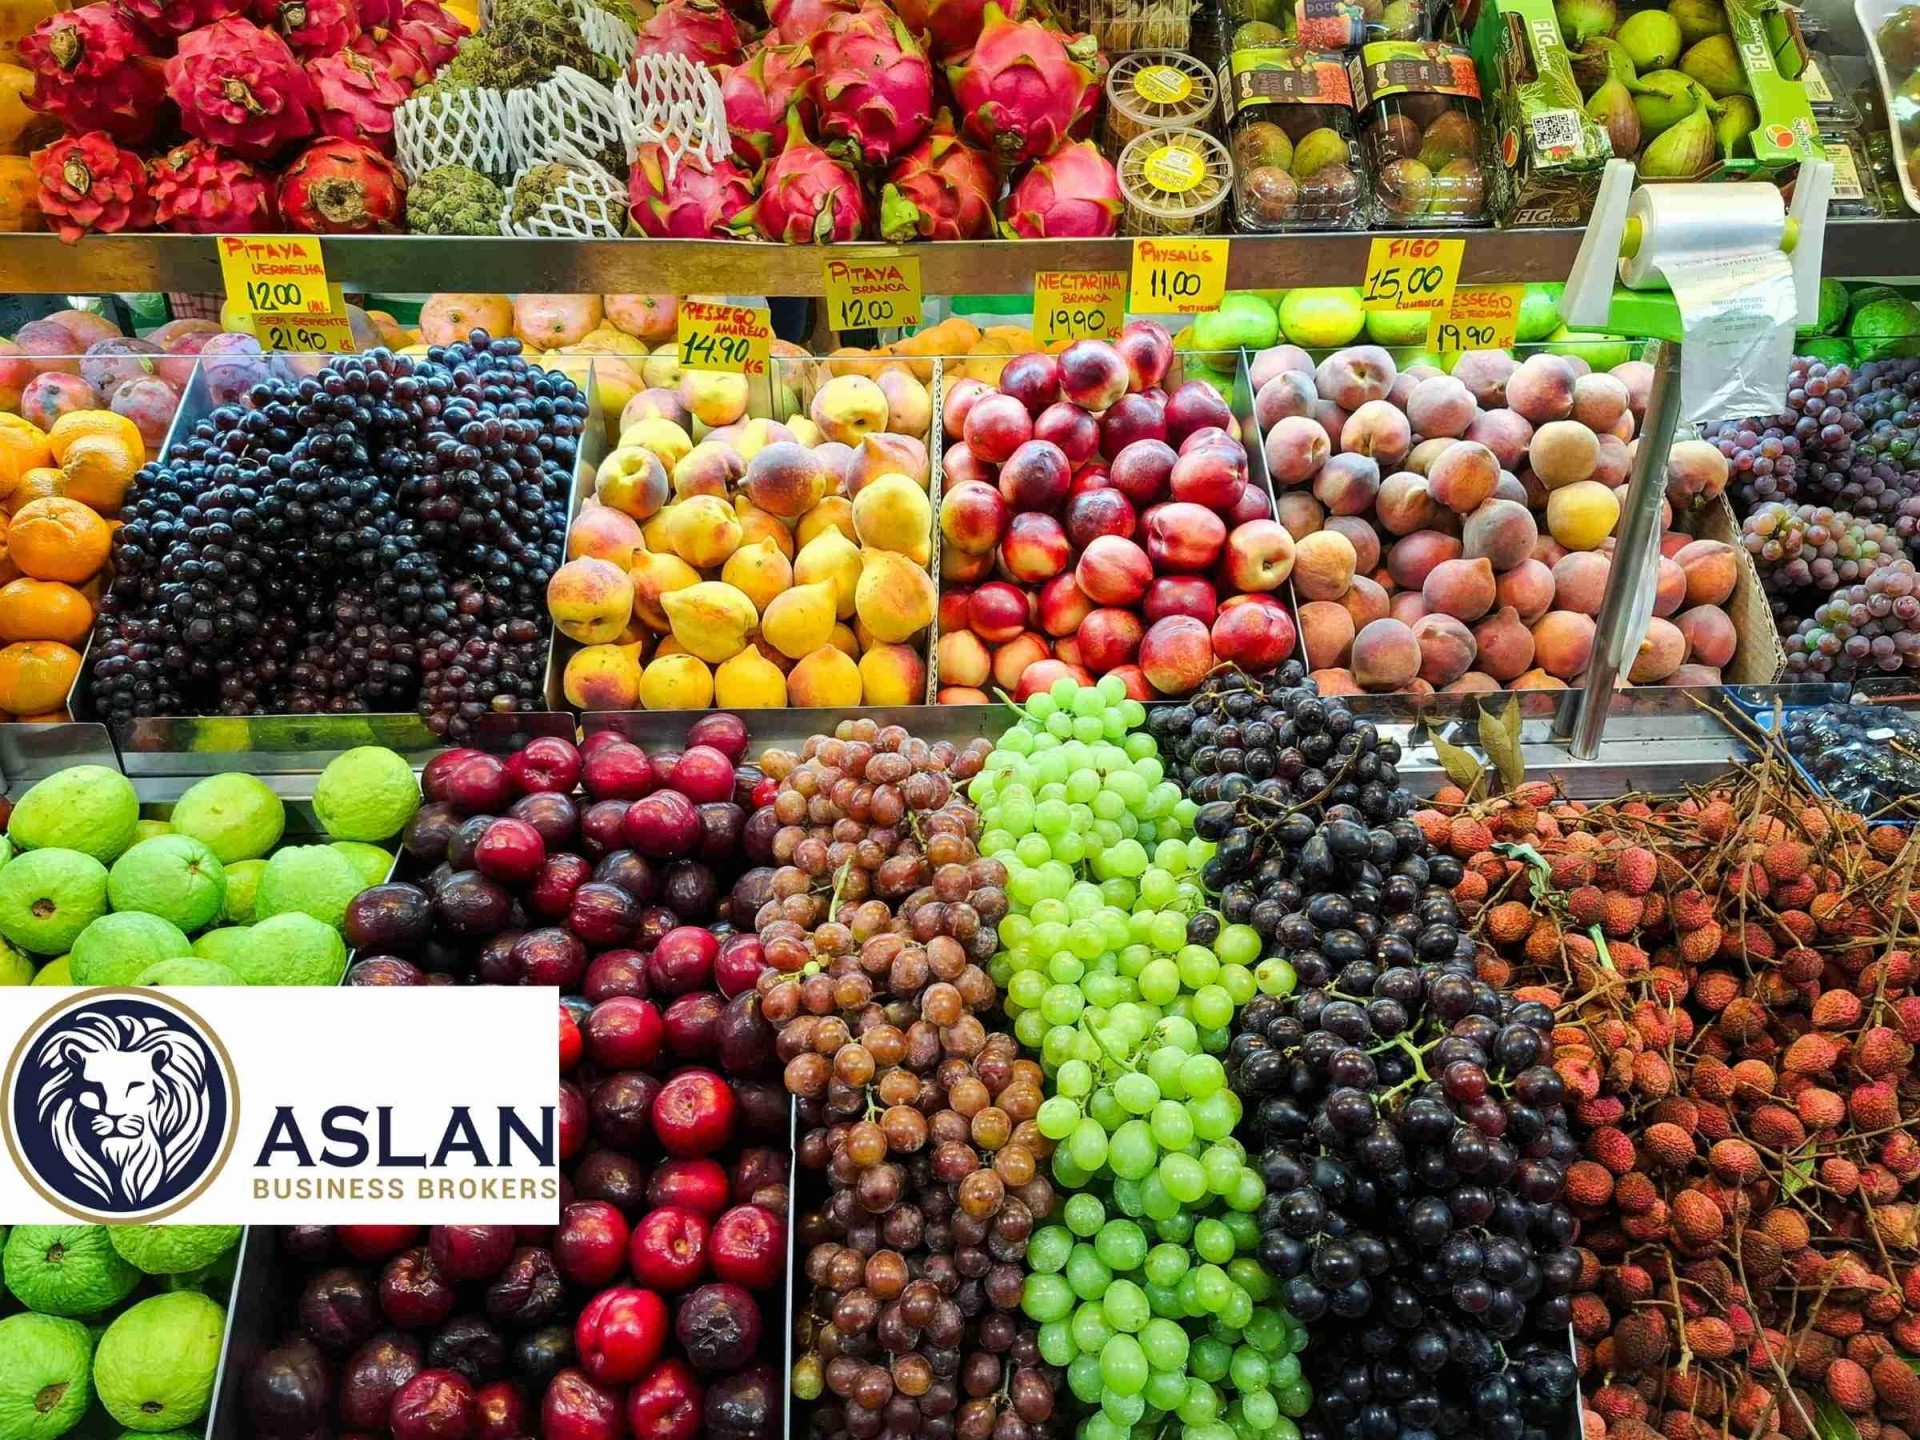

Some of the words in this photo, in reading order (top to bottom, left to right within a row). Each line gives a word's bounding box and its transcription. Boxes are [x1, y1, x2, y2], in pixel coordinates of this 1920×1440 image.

[1516, 210, 1552, 222] FIG
[1389, 239, 1440, 258] FIGO
[1151, 269, 1201, 301] 11,00
[1363, 265, 1443, 303] 15,00
[1450, 293, 1513, 309] ESSEGO
[682, 302, 756, 326] PESSEGO
[1049, 309, 1105, 339] 19,90
[714, 323, 768, 338] AMARELO
[1437, 324, 1495, 351] 19,90
[744, 358, 763, 374] KG
